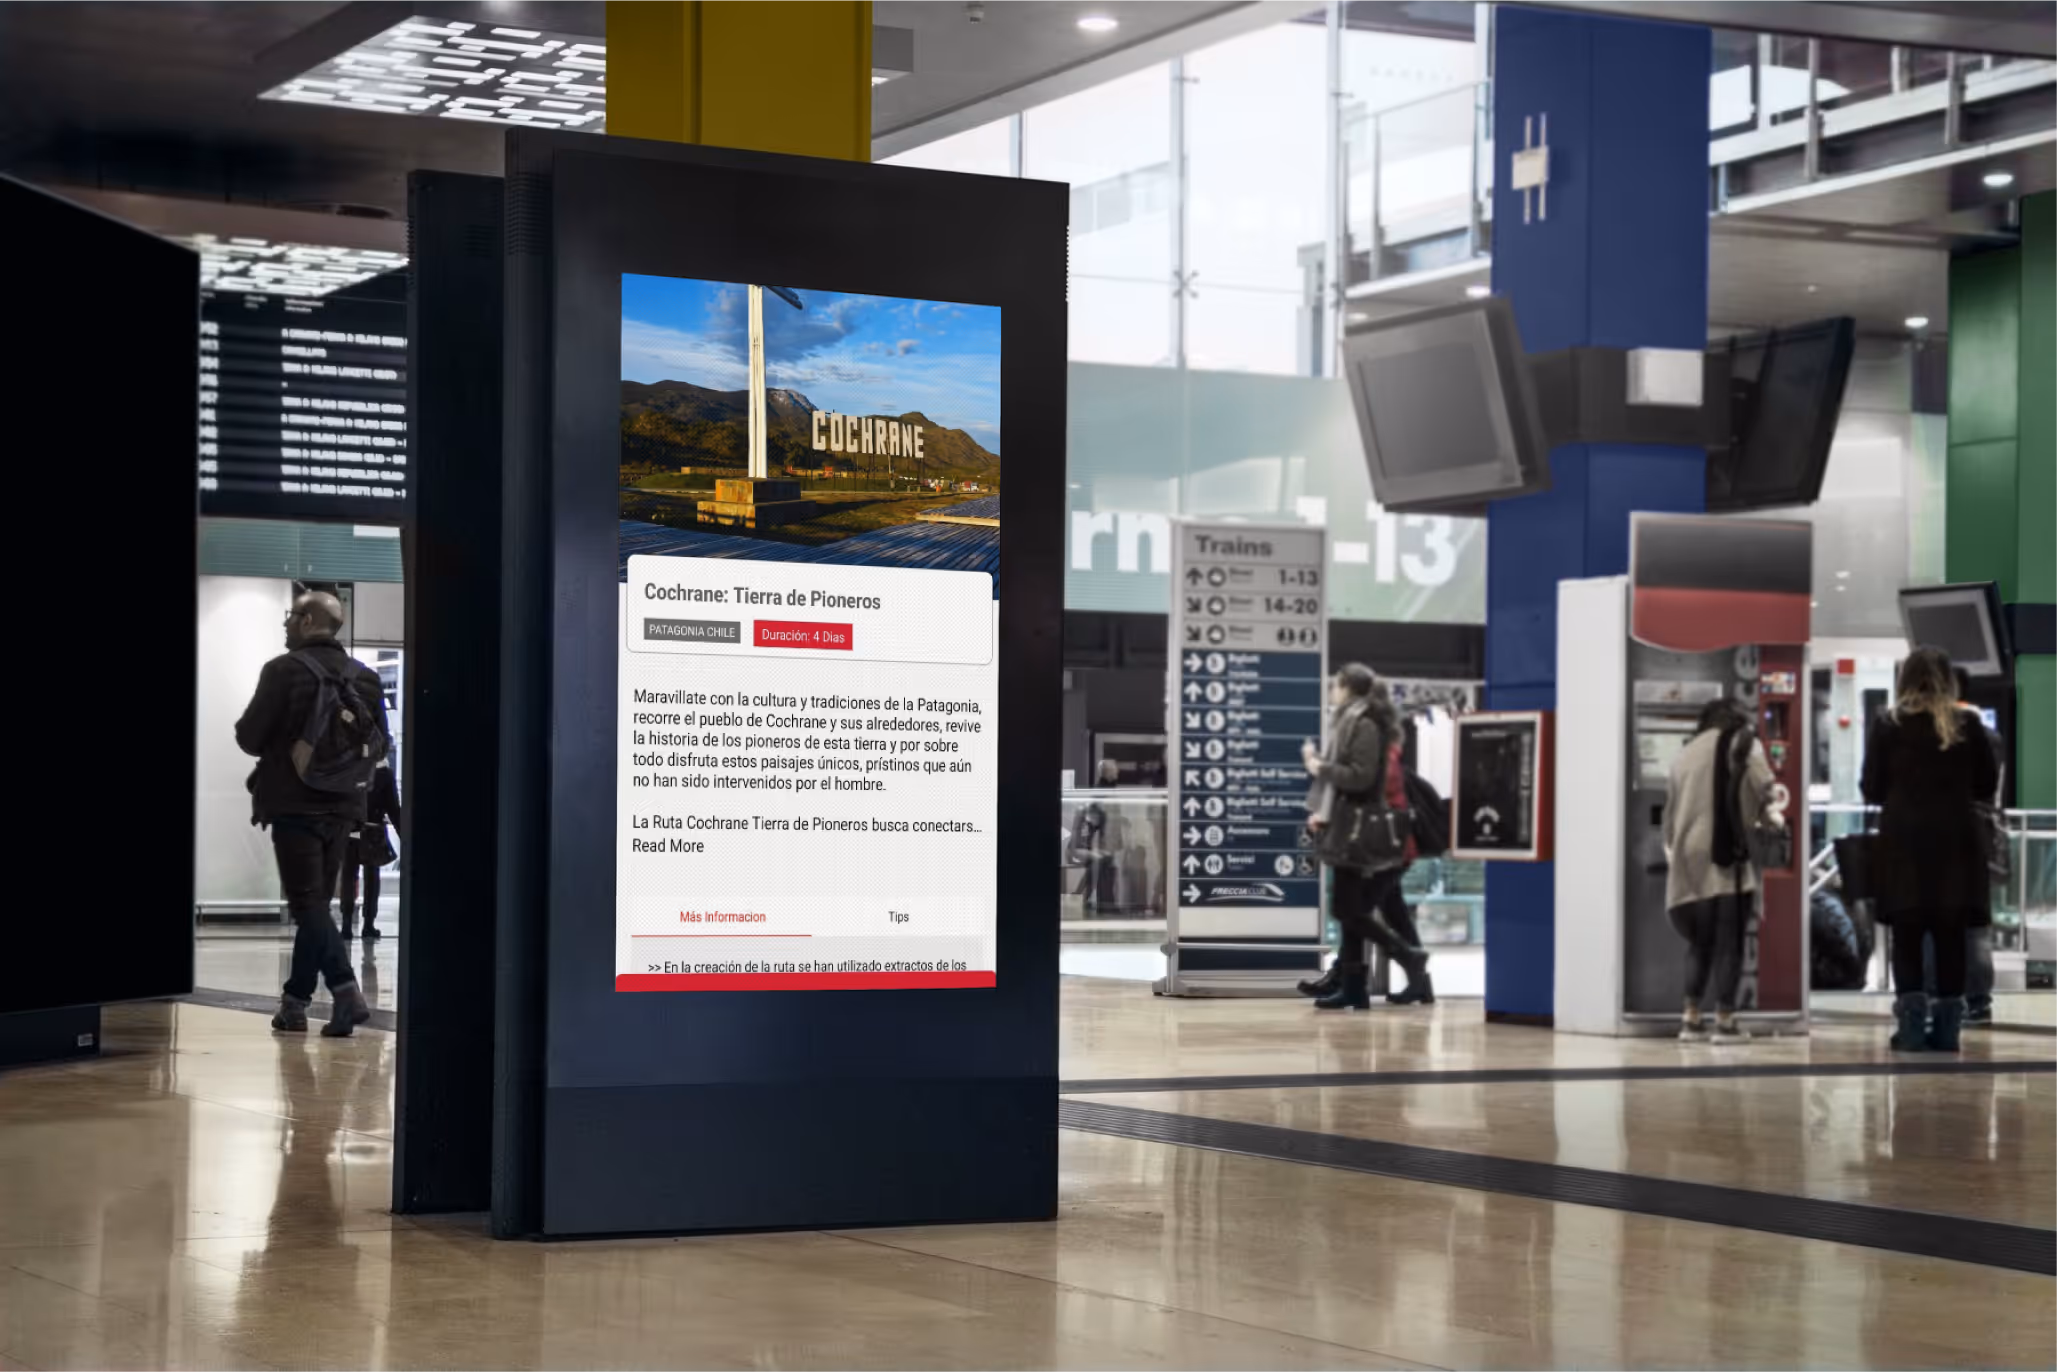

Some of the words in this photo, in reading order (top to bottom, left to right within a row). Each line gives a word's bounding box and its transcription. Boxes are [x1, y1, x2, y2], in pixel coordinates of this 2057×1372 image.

[811, 410, 925, 459] COCHRANE
[1195, 535, 1272, 557] Trains
[1279, 569, 1318, 587] 1-13
[644, 582, 729, 603] Cochrane:
[733, 586, 782, 606] Tierra
[786, 588, 807, 607] de
[810, 590, 881, 610] Pioneros
[1264, 597, 1318, 615] 14-20
[649, 624, 705, 637] PATAGONIA
[706, 626, 736, 638] CHILE
[762, 628, 810, 641] Duración:
[813, 630, 820, 642] 4
[823, 630, 845, 644] Dias
[634, 688, 707, 705] Maravillate
[710, 694, 734, 706] con
[737, 691, 749, 706] la
[752, 692, 797, 708] cultura
[800, 697, 808, 712] y
[810, 694, 881, 710] tradiciones
[884, 696, 900, 711] de
[903, 696, 914, 711] la
[917, 697, 982, 716] Patagonia,
[633, 712, 681, 725] recorre
[684, 710, 696, 726] el
[699, 711, 743, 729] pueblo
[746, 712, 763, 727] de
[766, 713, 827, 729] Cochrane
[830, 718, 837, 733] y
[840, 718, 863, 730] sus
[866, 716, 943, 734] alrededores,
[945, 719, 981, 734] revive
[633, 729, 645, 745] la
[649, 730, 698, 747] historia
[702, 732, 719, 747] de
[722, 732, 742, 748] los
[745, 733, 801, 751] pioneros
[804, 734, 820, 750] de
[823, 737, 851, 750] esta
[853, 736, 887, 751] tierra
[889, 740, 897, 755] y
[900, 740, 921, 754] por
[923, 738, 959, 753] sobre
[632, 751, 664, 767] todo
[667, 751, 718, 768] disfruta
[721, 755, 758, 768] estos
[761, 755, 815, 773] paisajes
[817, 755, 863, 772] únicos,
[866, 756, 920, 774] prístinos
[923, 761, 946, 775] que
[949, 758, 972, 773] aún
[633, 775, 650, 787] no
[653, 772, 678, 788] han
[681, 773, 710, 789] sido
[713, 774, 792, 790] intervenidos
[795, 779, 818, 793] por
[820, 776, 831, 790] el
[834, 776, 887, 791] hombre.
[632, 814, 649, 829] La
[653, 814, 683, 830] Ruta
[686, 815, 749, 830] Cochrane
[752, 815, 790, 831] Tierra
[793, 816, 809, 831] de
[813, 816, 868, 832] Pioneros
[872, 817, 909, 832] busca
[632, 837, 666, 853] Read
[670, 838, 705, 853] More
[680, 910, 703, 923] Más
[704, 910, 767, 923] Informacion
[888, 911, 910, 925] Tips
[664, 961, 679, 973] En
[681, 960, 691, 973] la
[694, 960, 742, 973] creación
[744, 960, 759, 973] de
[761, 960, 771, 973] la
[773, 961, 795, 973] ruta
[798, 963, 812, 973] se
[814, 959, 834, 972] han
[837, 959, 882, 972] utilizado
[884, 961, 934, 972] extractos
[936, 959, 949, 972] de
[950, 959, 968, 972] los
